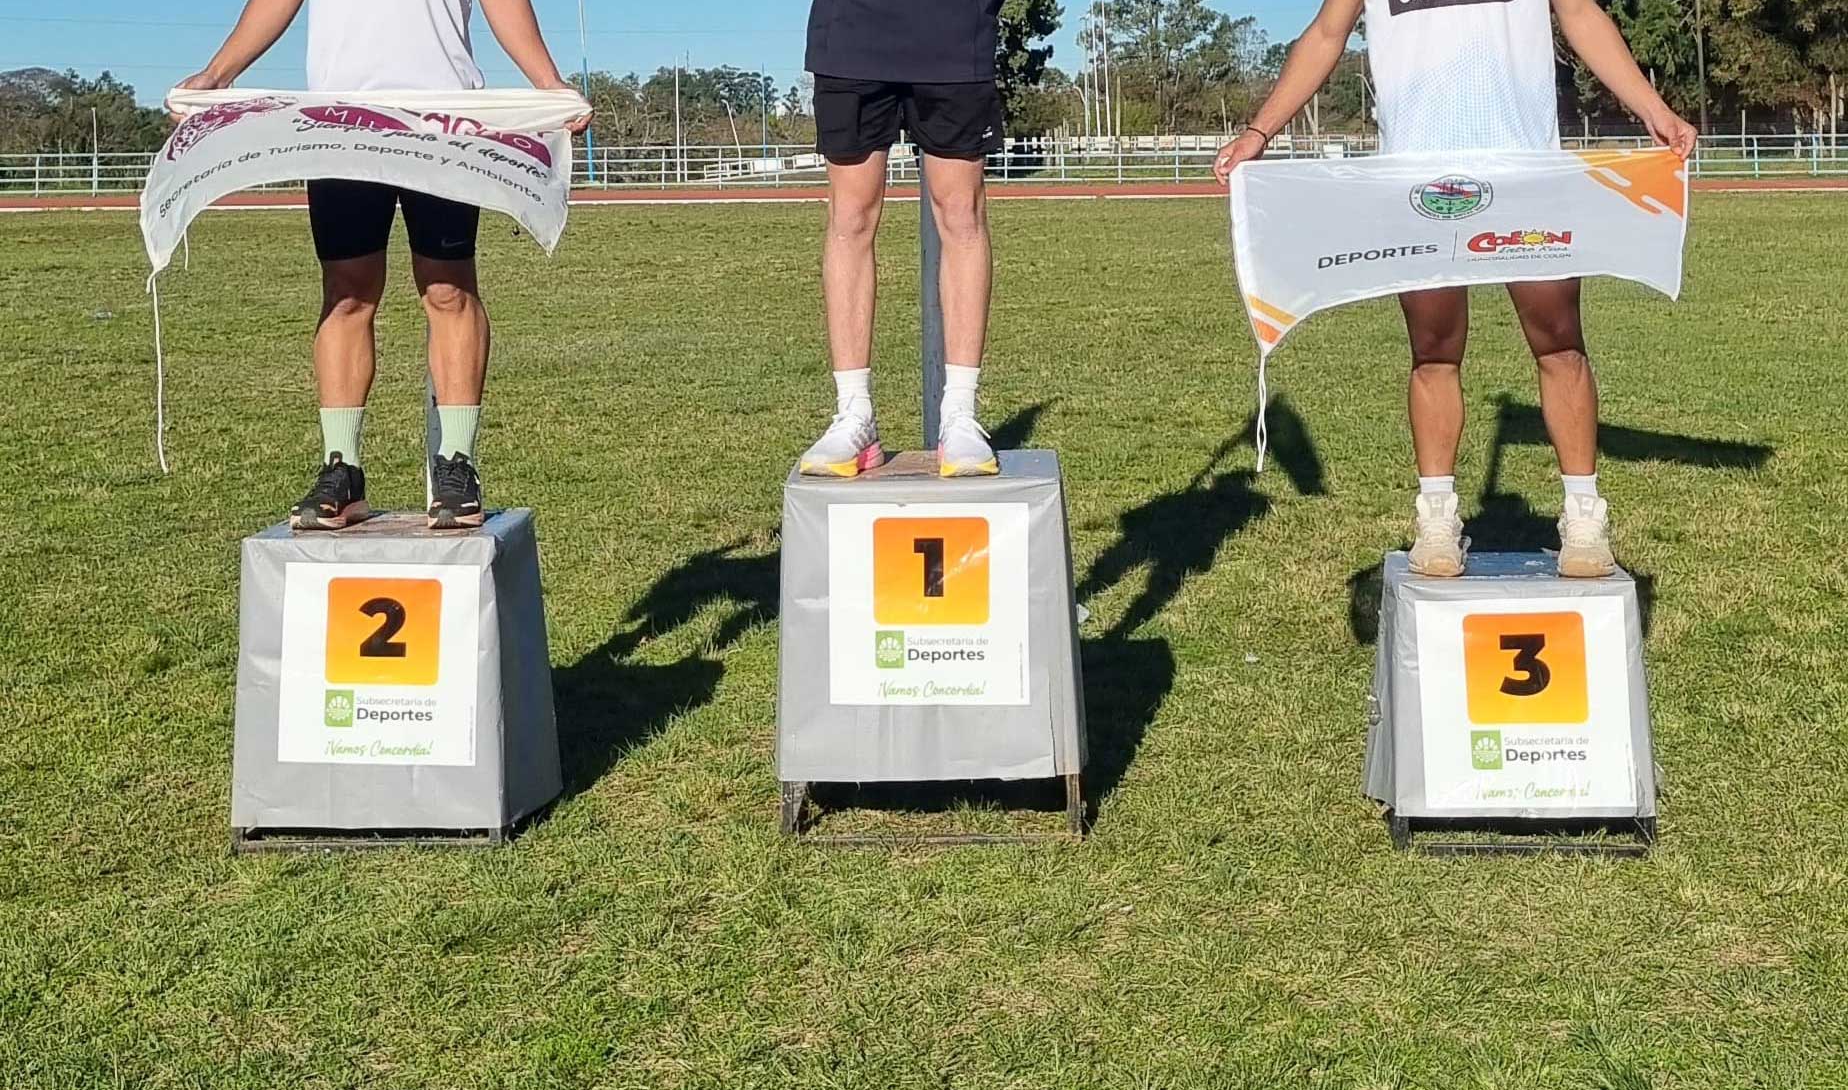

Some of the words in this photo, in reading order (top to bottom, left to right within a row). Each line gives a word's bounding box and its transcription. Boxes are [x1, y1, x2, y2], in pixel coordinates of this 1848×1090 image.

[448, 140, 474, 151] al
[238, 152, 261, 163] de
[270, 142, 346, 156] Turismo,
[354, 143, 434, 160] Deporte
[440, 156, 452, 166] y
[1317, 243, 1438, 270] DEPORTES
[913, 538, 944, 597] 1
[358, 597, 406, 657] 2
[976, 637, 989, 646] de
[908, 648, 985, 664] Deportes
[1499, 634, 1551, 696] 3
[424, 697, 437, 706] de
[357, 708, 433, 723] Deportes
[1576, 736, 1589, 745] de
[1505, 748, 1587, 764] Deportes
